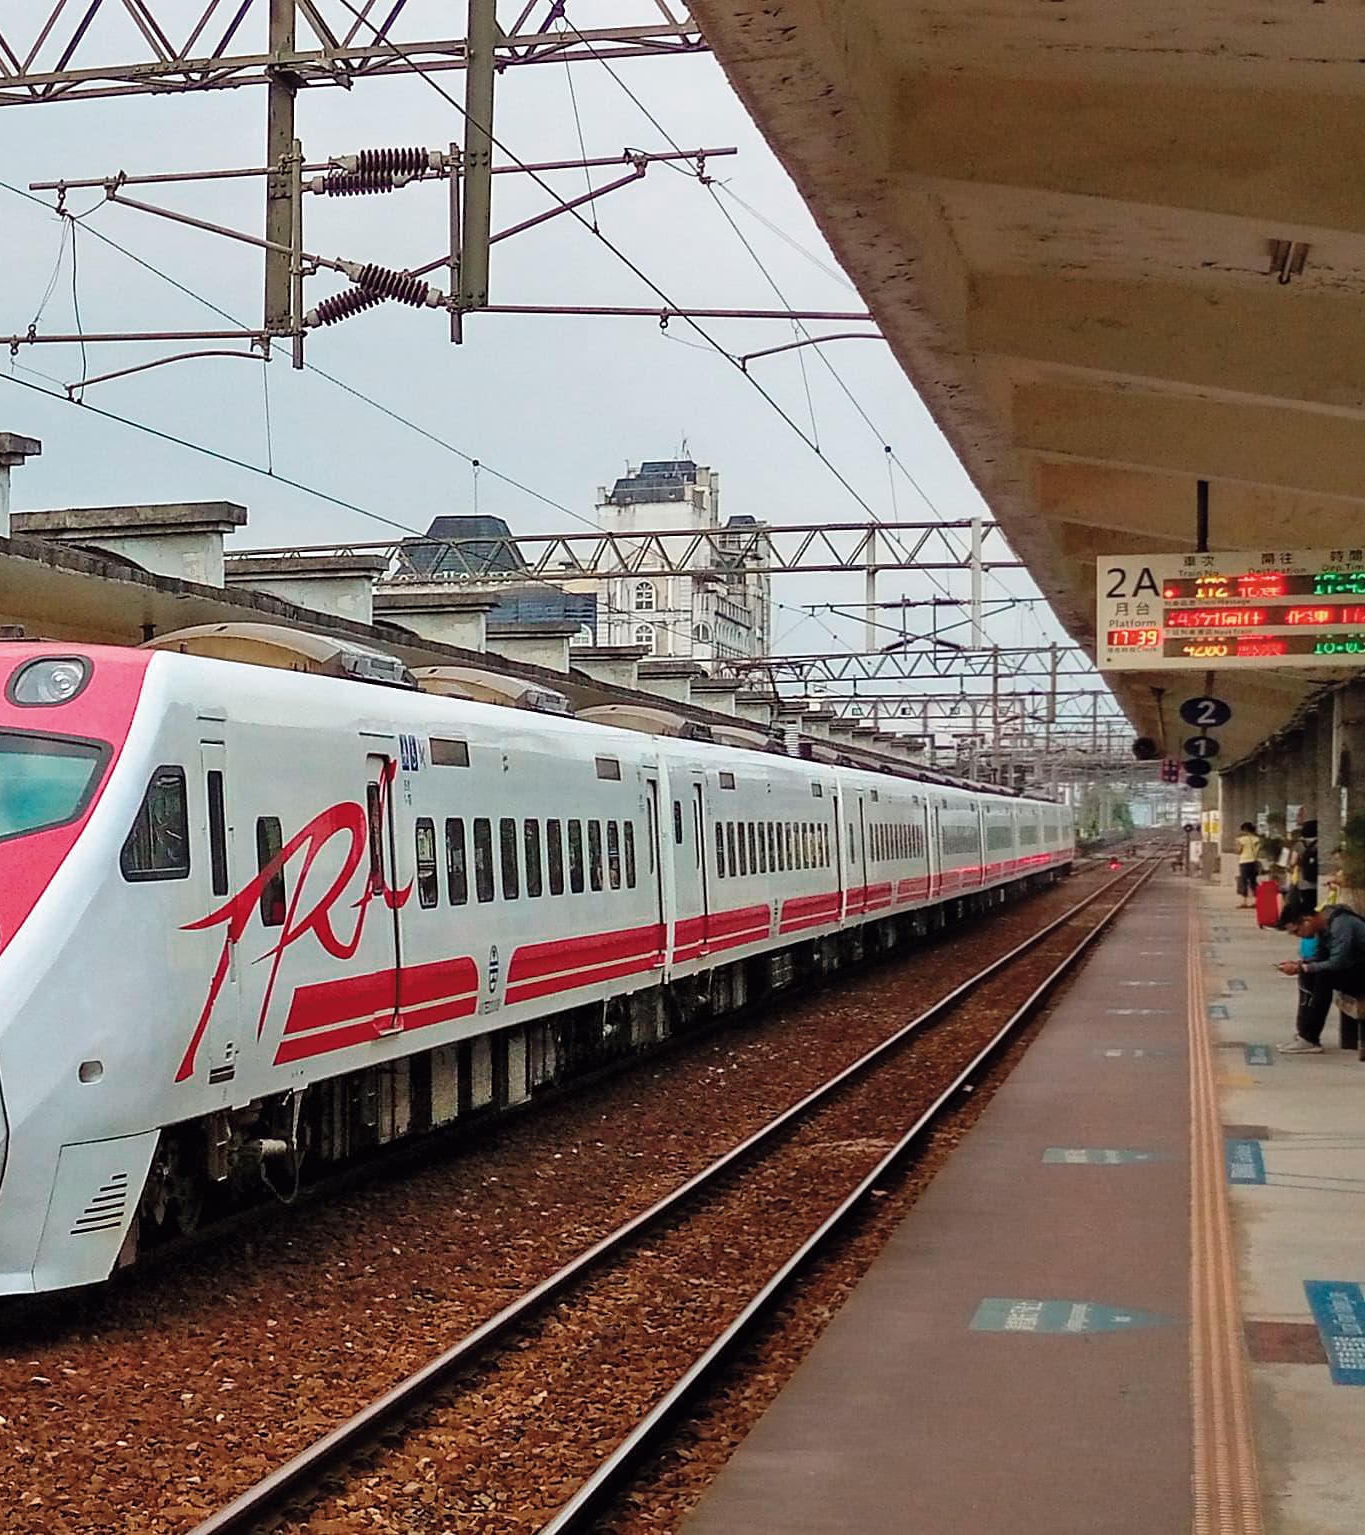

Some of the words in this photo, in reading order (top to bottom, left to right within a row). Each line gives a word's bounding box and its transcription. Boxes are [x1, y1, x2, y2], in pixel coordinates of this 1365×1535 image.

[1106, 567, 1160, 598] 2A
[1116, 602, 1149, 616] 月台
[1109, 619, 1156, 627] Platform
[1197, 701, 1216, 724] 2
[1194, 740, 1207, 756] 1
